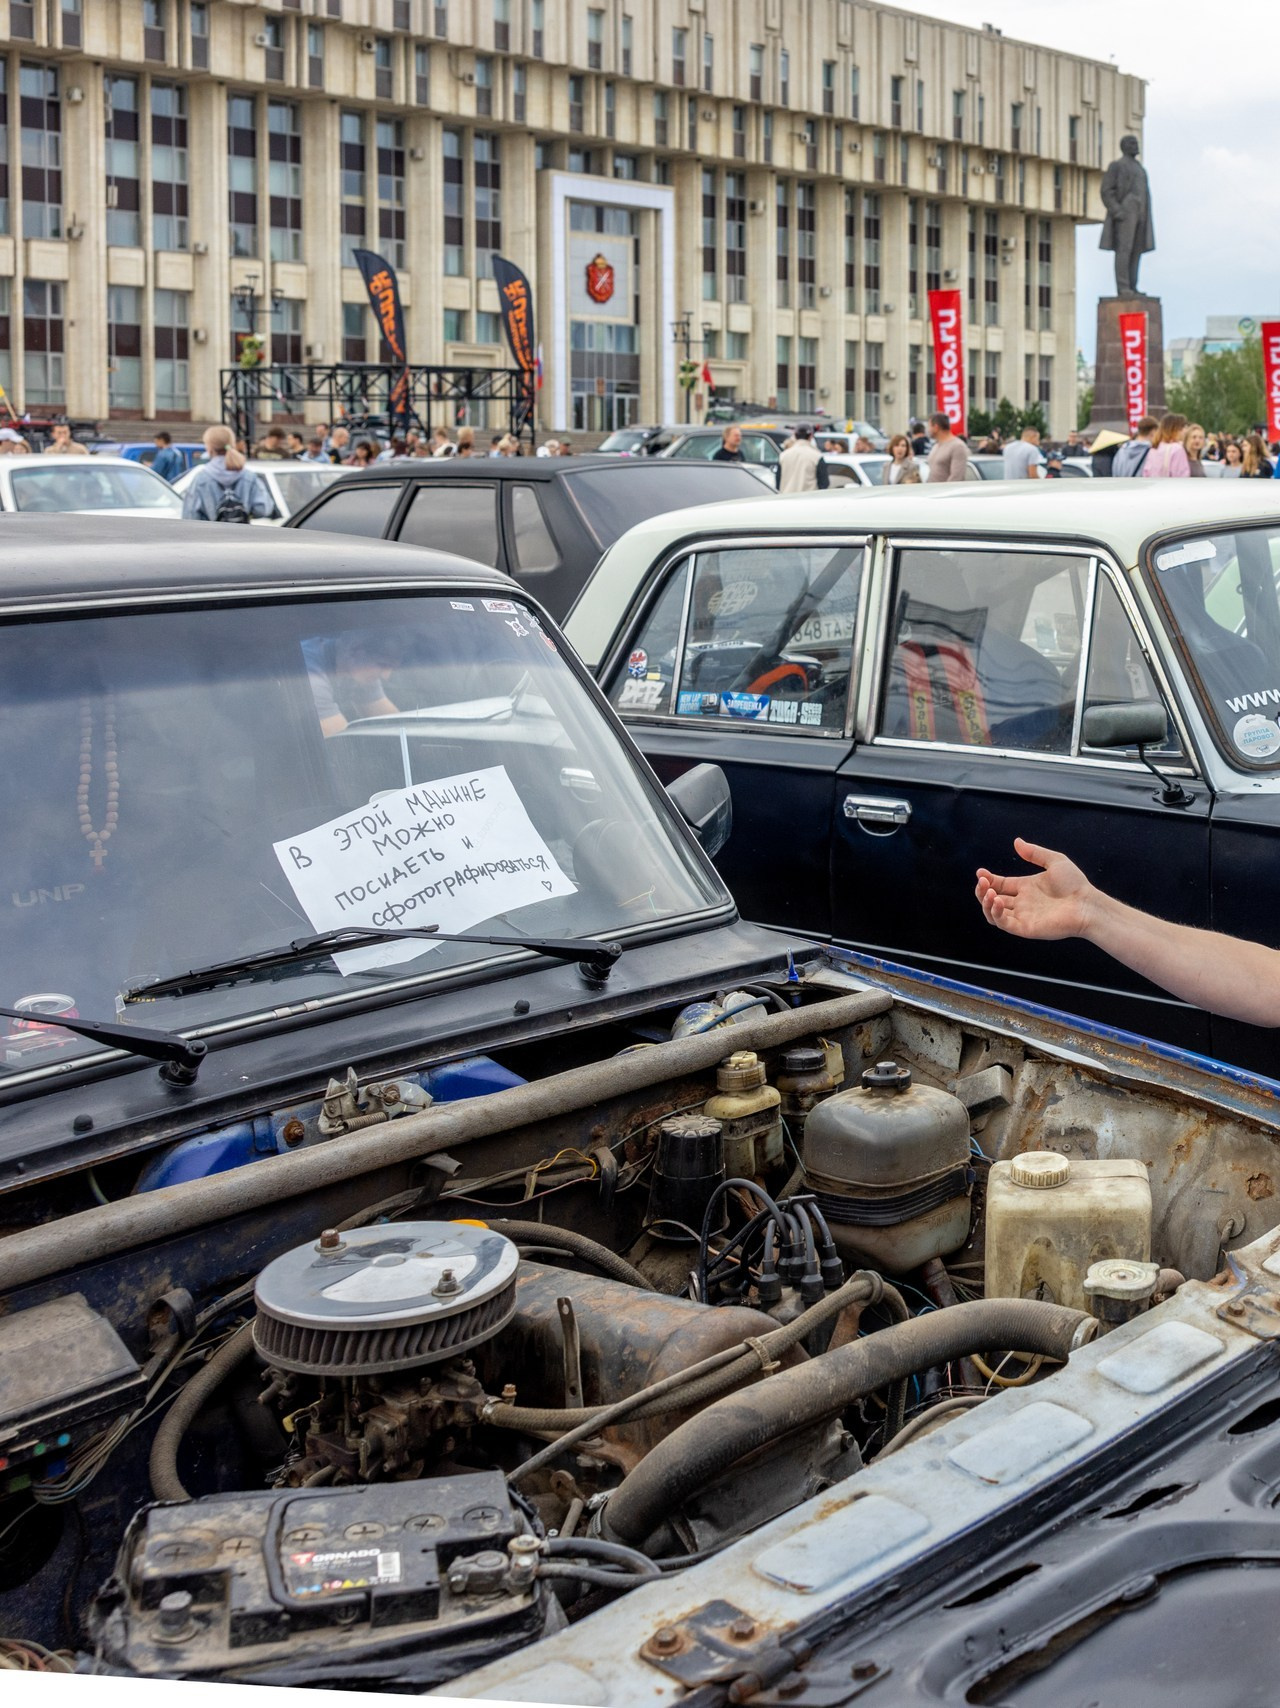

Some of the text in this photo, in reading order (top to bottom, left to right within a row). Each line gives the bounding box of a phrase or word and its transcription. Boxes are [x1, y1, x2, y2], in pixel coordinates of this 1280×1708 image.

[938, 308, 961, 424] auto.ru
[1243, 733, 1275, 745] ПАРОВОЗ
[1244, 728, 1270, 738] ГРУППА
[288, 778, 487, 870] В ЭТОЙ МАШИНЕ
[372, 813, 456, 857] МОЖНО
[292, 1548, 380, 1564] TORNADO
